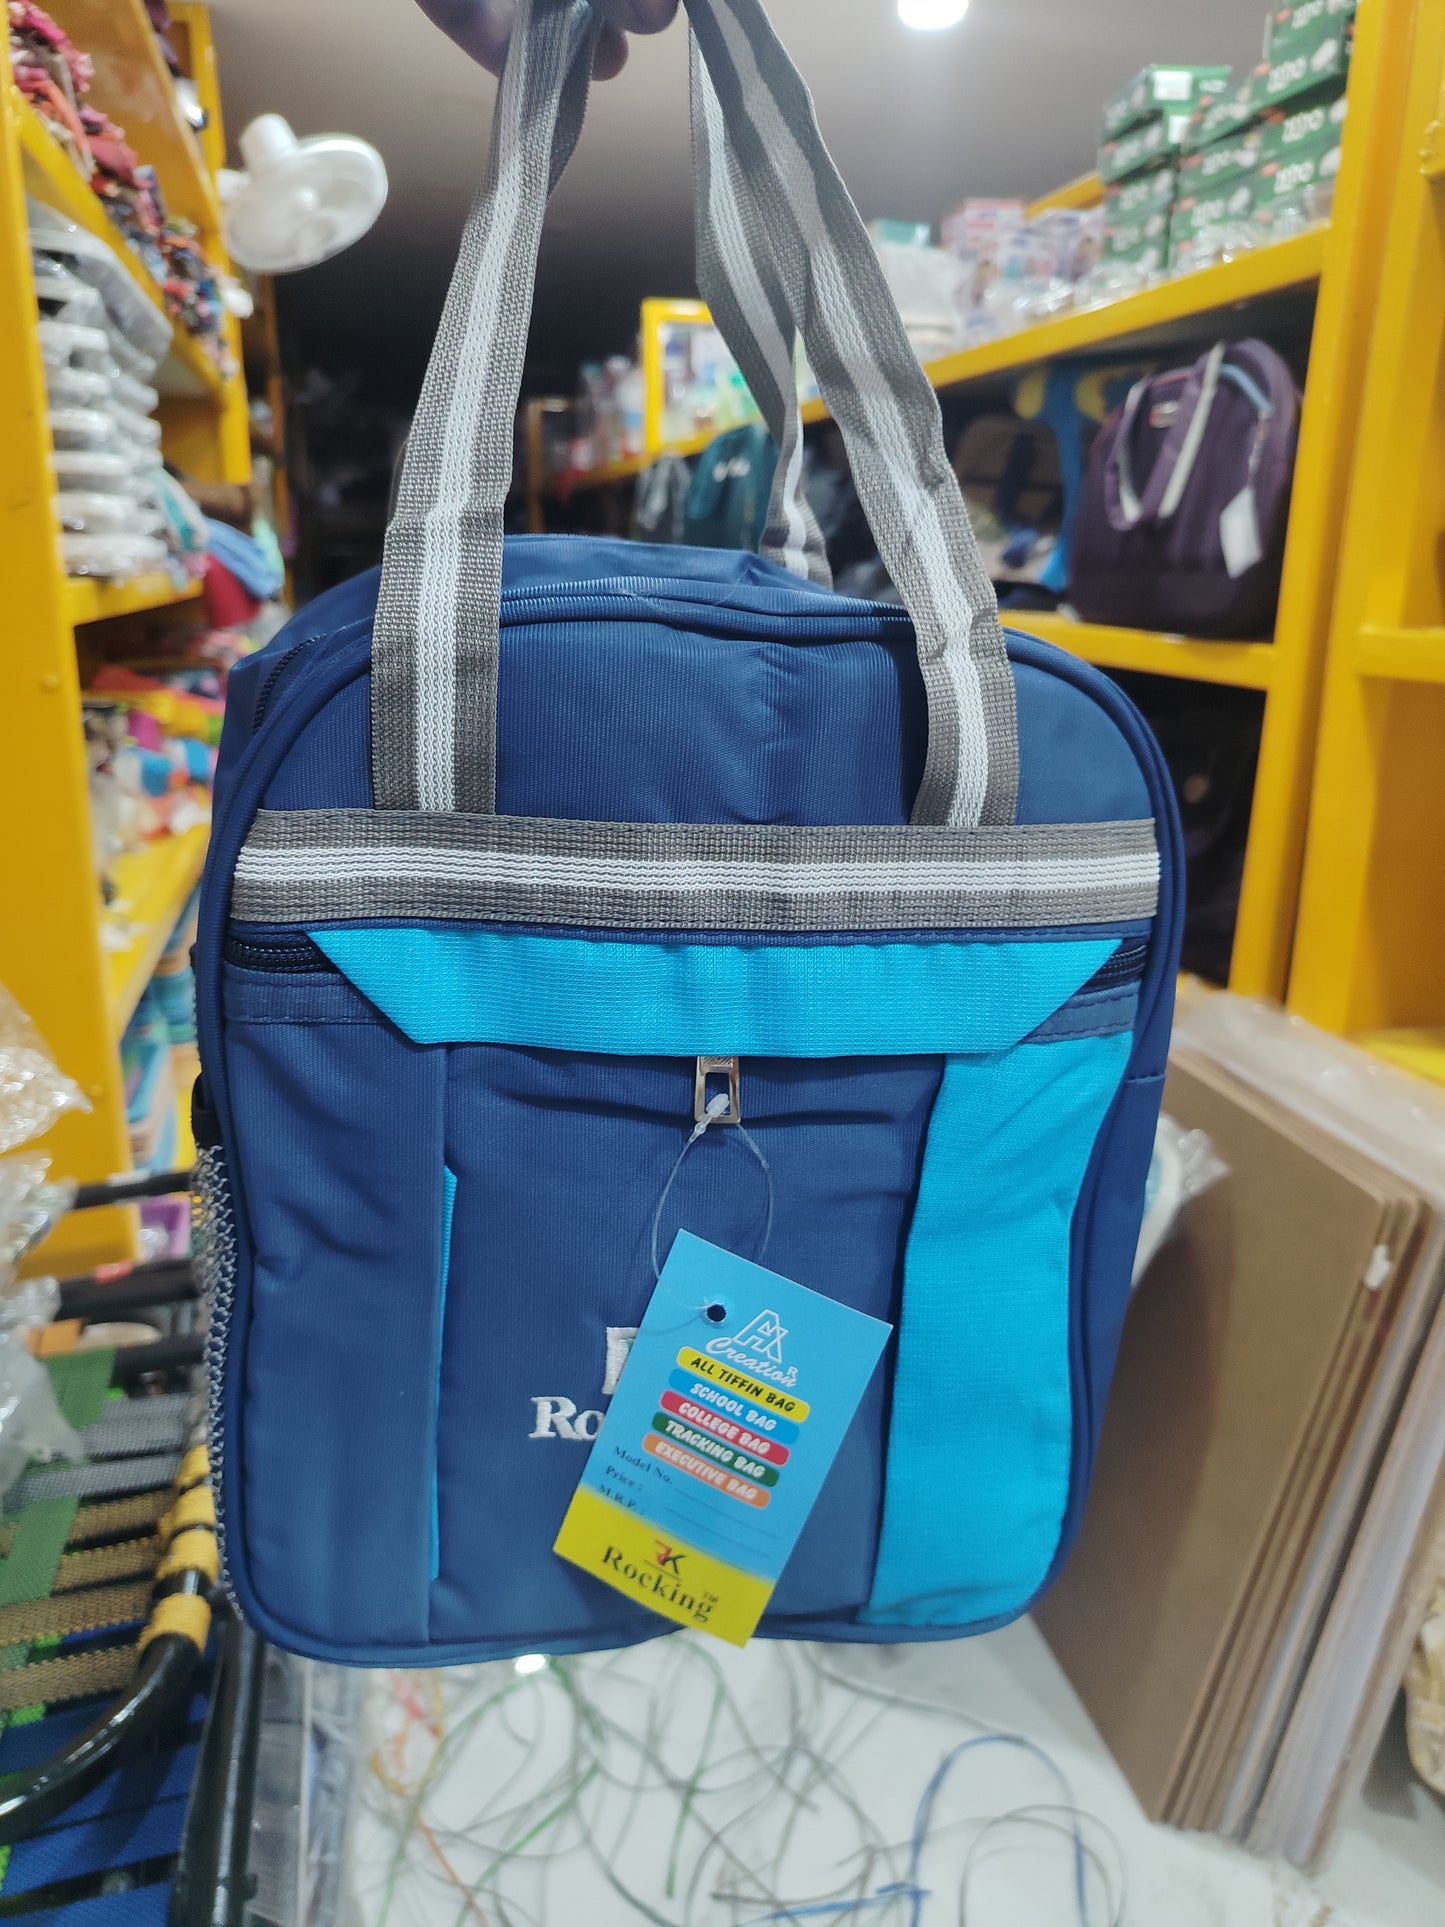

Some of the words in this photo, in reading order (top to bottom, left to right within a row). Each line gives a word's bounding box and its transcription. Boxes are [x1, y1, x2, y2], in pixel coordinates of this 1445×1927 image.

[691, 1357, 715, 1375] ALL
[718, 1369, 763, 1397] TIFFIN
[765, 1392, 796, 1412] BAG
[705, 1337, 797, 1387] Creation
[528, 1396, 605, 1441] Ro
[678, 1402, 740, 1440] COLLEGE
[738, 1432, 771, 1454] BAG
[690, 1383, 744, 1416] SCHOOL
[745, 1409, 777, 1431] BAG
[613, 1446, 652, 1472] Model
[655, 1467, 673, 1485] No.
[655, 1441, 727, 1484] EXECUTIVE
[726, 1478, 758, 1499] BAG
[665, 1419, 735, 1462] TRACKING
[733, 1456, 766, 1478] BAG
[605, 1465, 636, 1488] Price
[602, 1545, 712, 1622] Rocking
